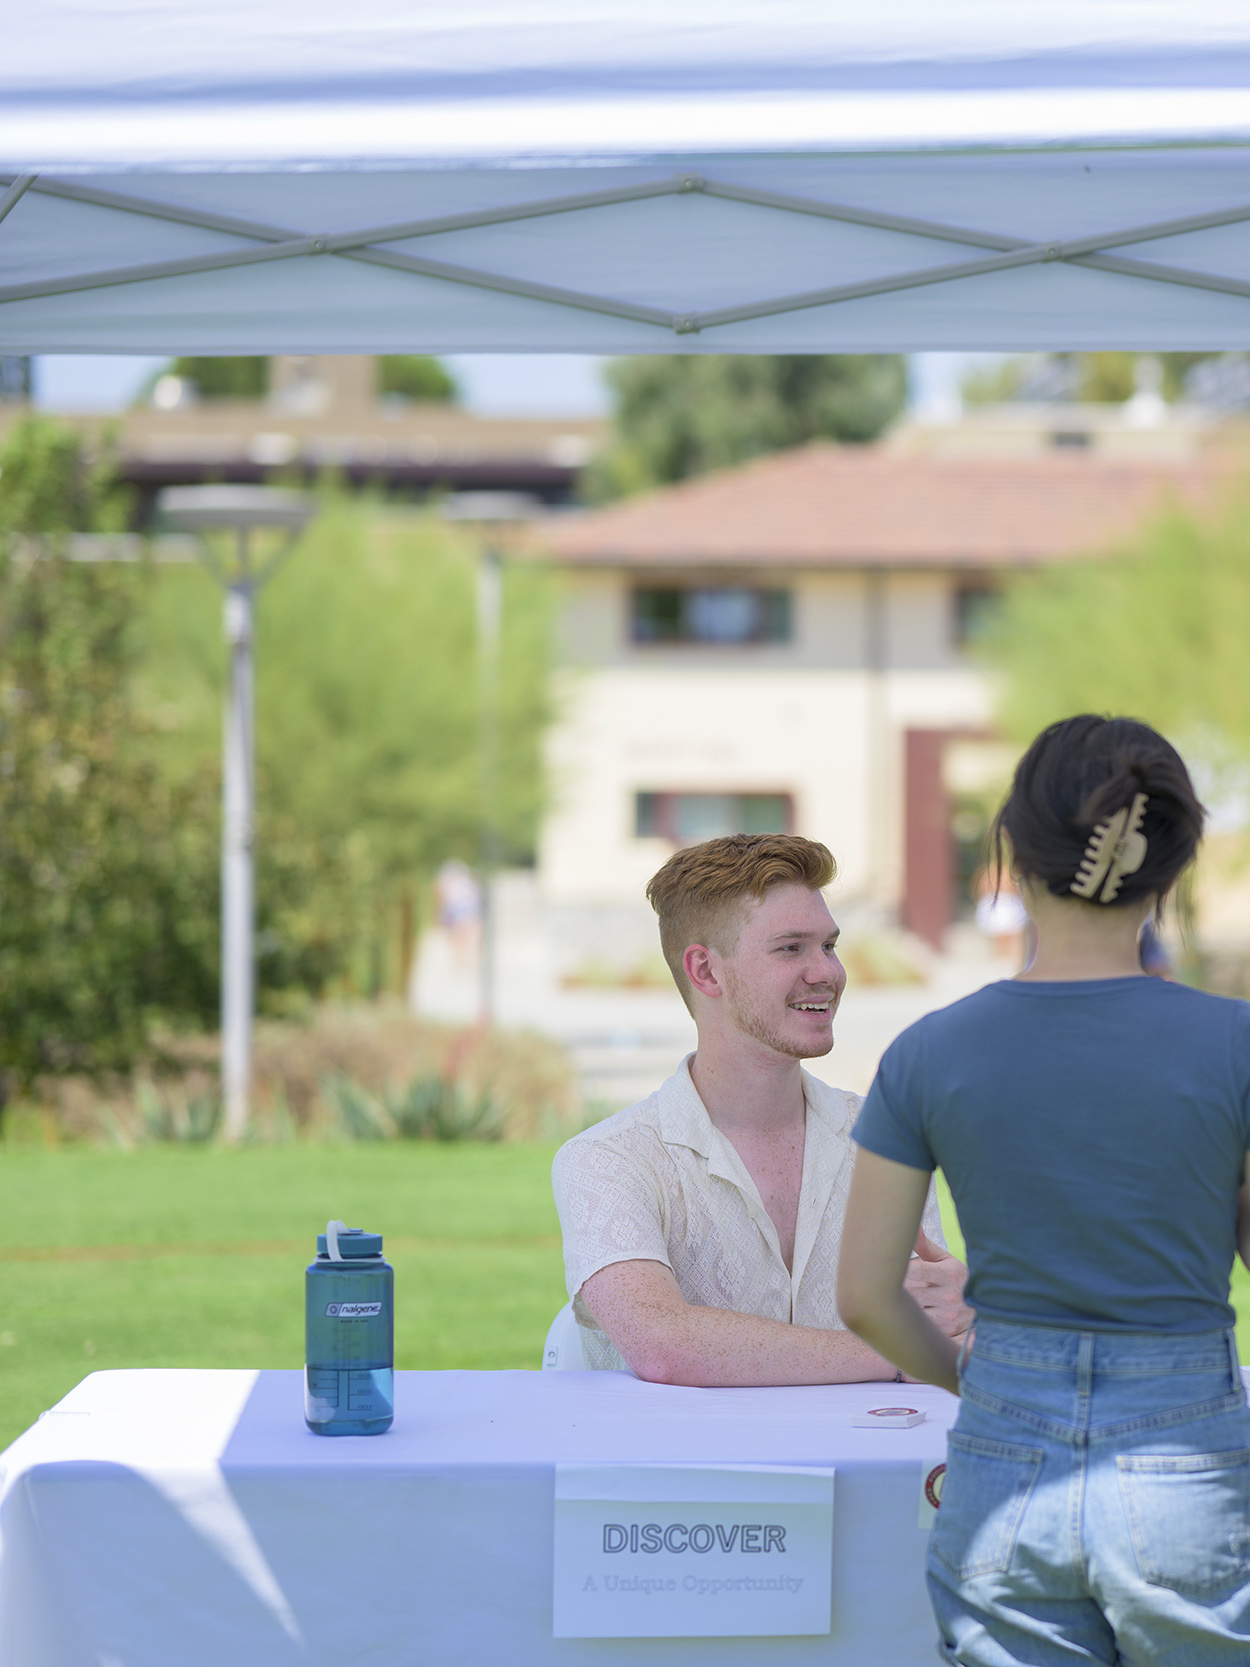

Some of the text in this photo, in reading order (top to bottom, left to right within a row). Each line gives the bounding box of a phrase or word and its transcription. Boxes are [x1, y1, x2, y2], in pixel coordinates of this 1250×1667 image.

[602, 1523, 787, 1553] DISCOVER
[581, 1575, 804, 1595] A Unique Opportunity
